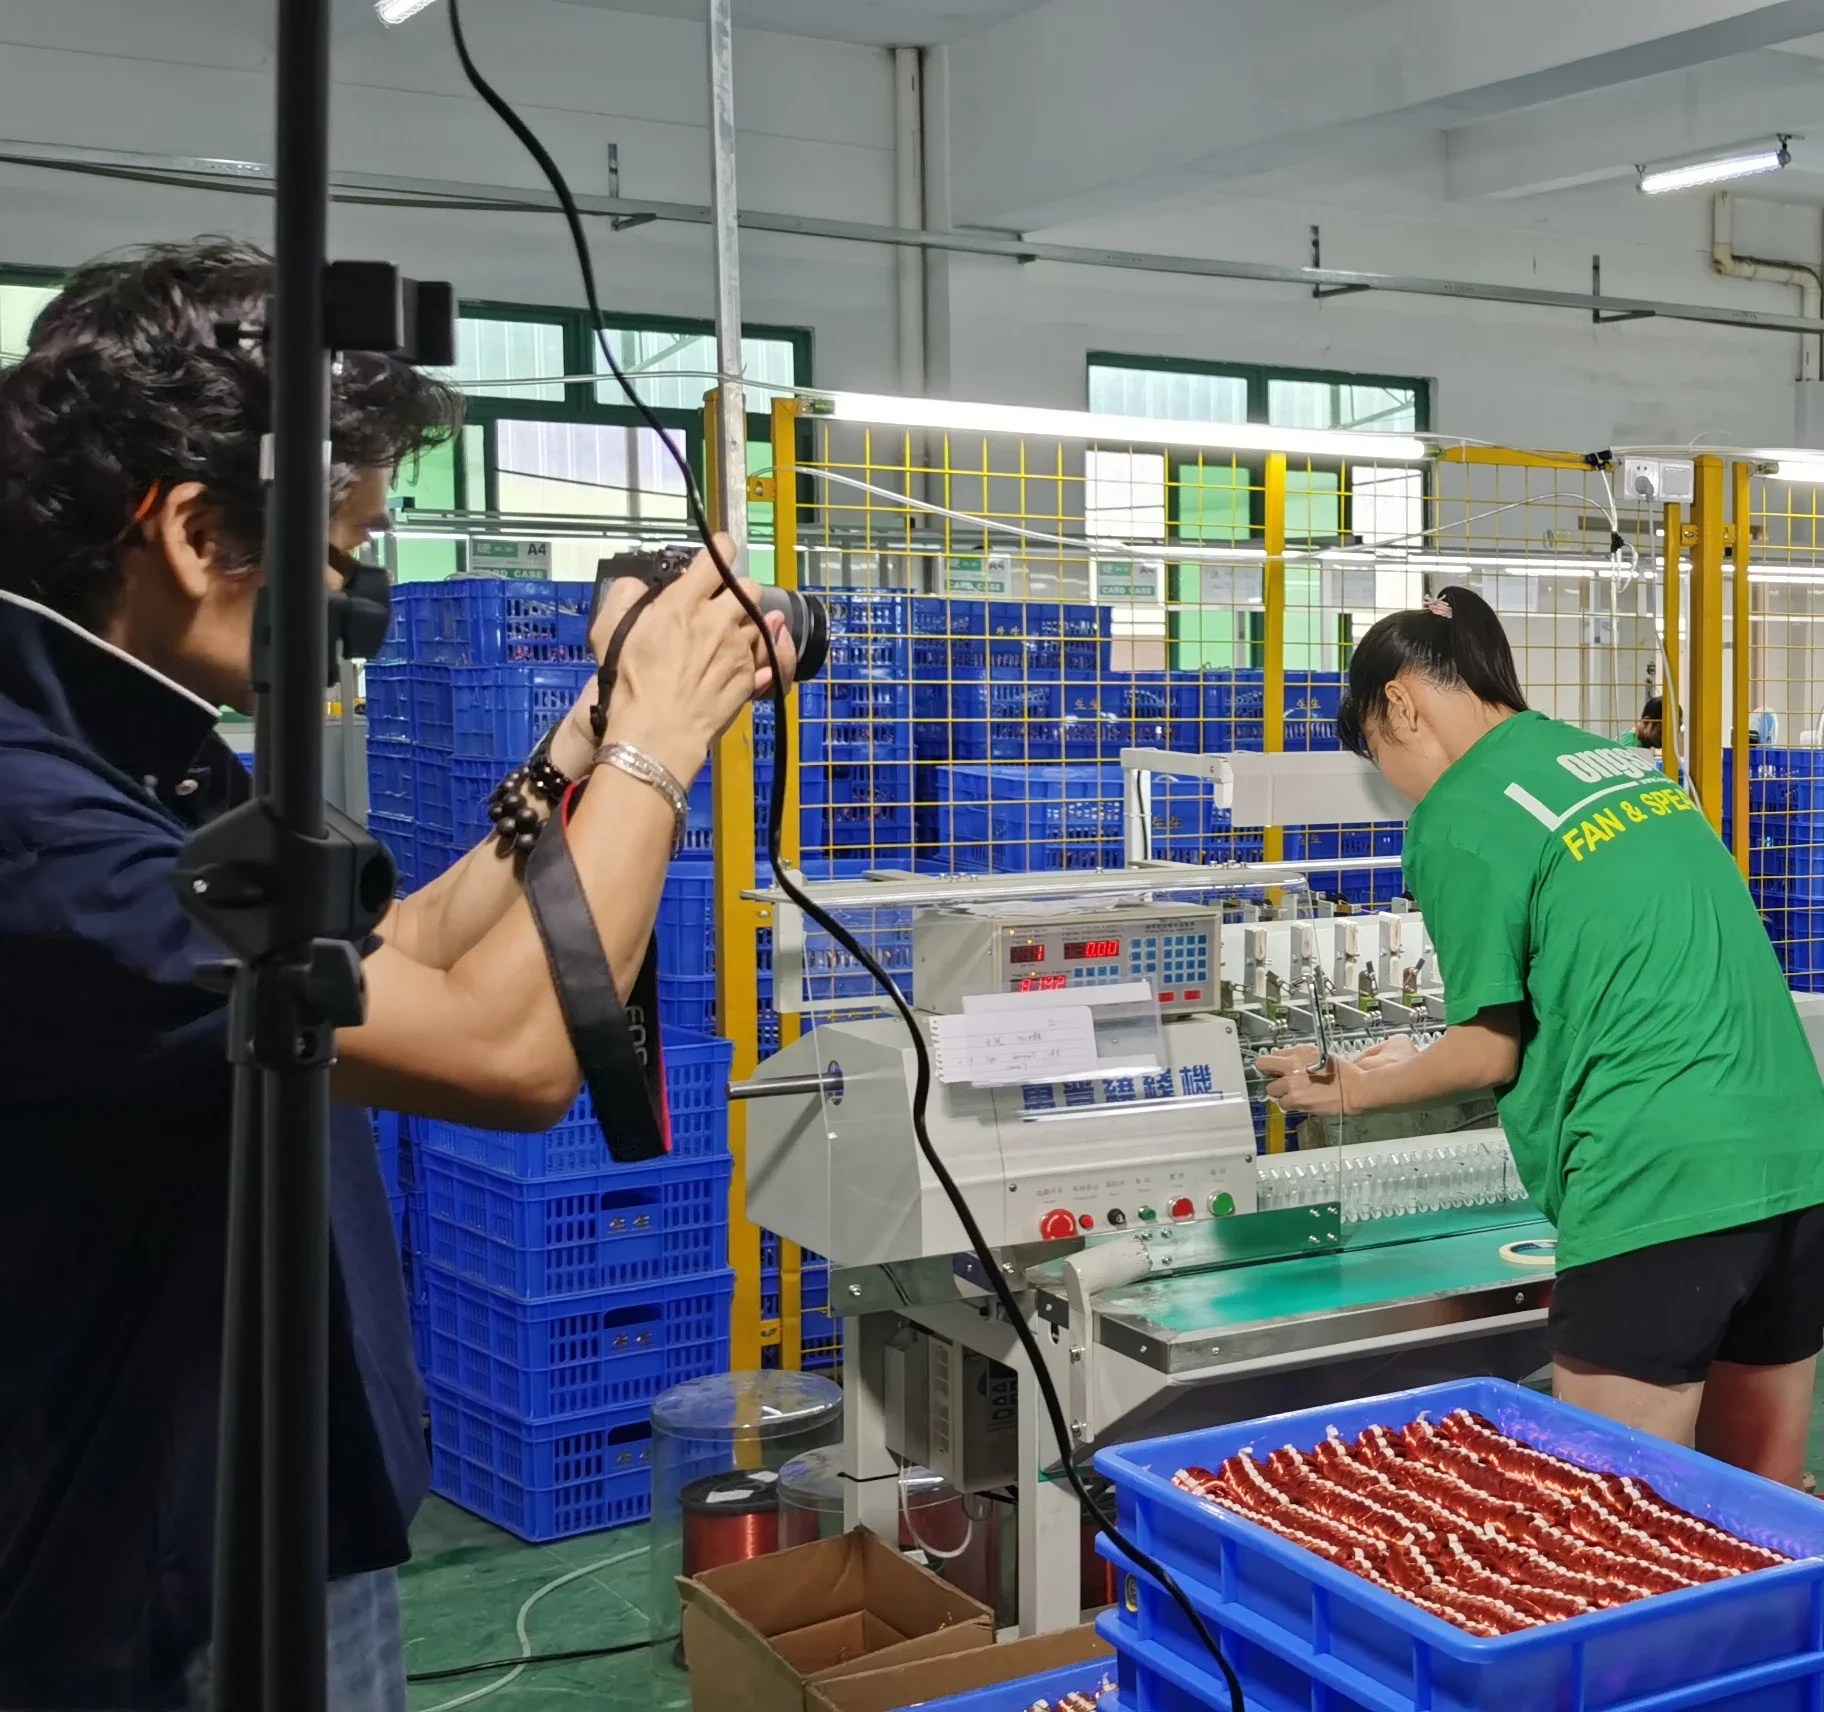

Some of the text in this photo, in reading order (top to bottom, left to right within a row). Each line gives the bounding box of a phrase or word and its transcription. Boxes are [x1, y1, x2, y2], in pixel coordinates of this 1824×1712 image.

[527, 543, 547, 556] A4
[1562, 808, 1626, 861] FAN
[1620, 801, 1648, 823] &
[1084, 940, 1118, 958] 0.00
